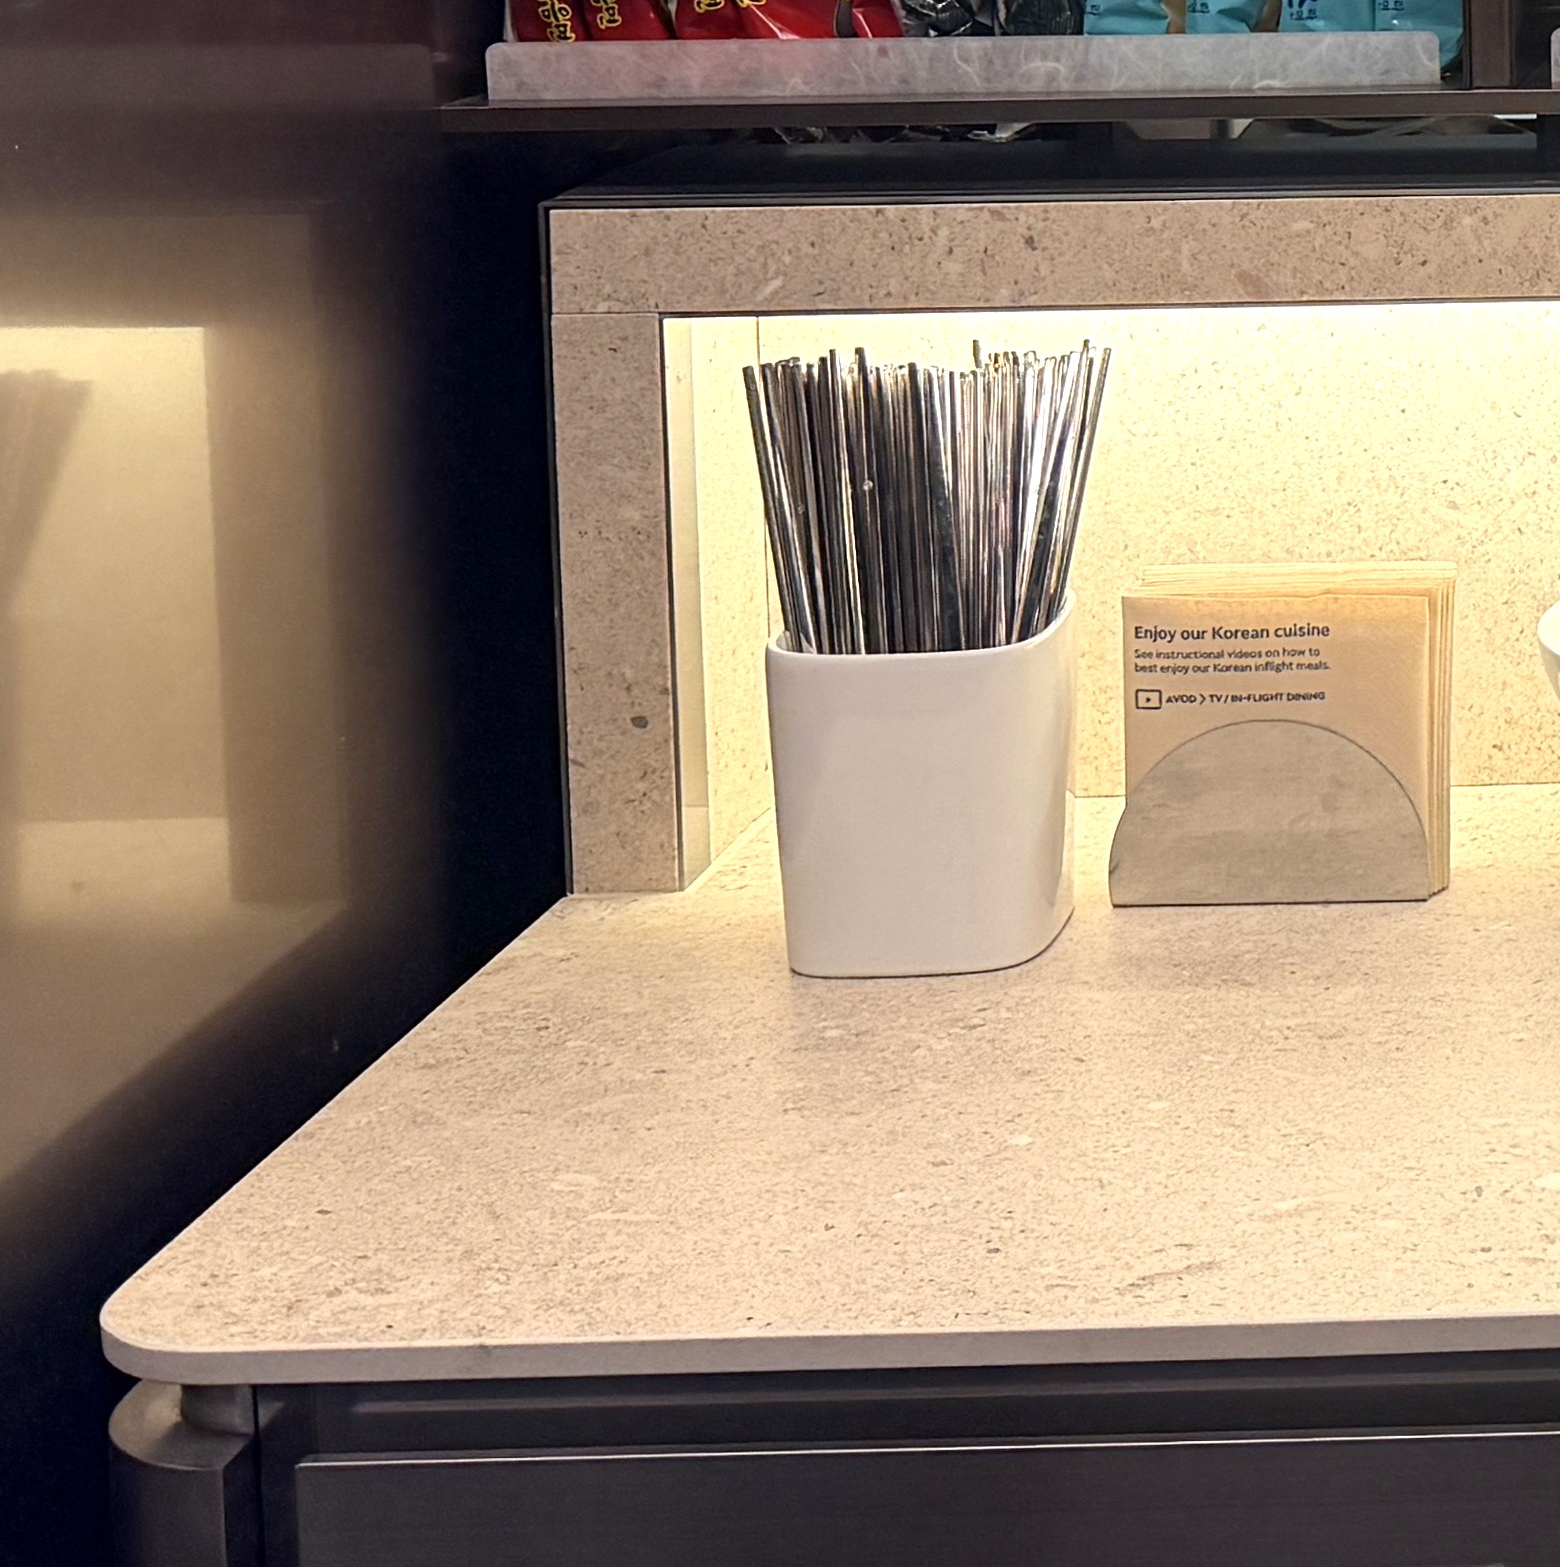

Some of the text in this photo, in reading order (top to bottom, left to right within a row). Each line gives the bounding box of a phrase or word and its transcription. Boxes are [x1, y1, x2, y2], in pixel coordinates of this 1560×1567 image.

[1134, 624, 1330, 642] Enjoy our Korean cuisine
[1134, 647, 1320, 660] See instructional videos on how to
[1134, 662, 1157, 674] best
[1160, 663, 1189, 676] enjoy
[1192, 663, 1210, 674] our
[1213, 662, 1252, 673] Korean
[1254, 661, 1293, 675] inflight
[1166, 694, 1196, 704] AVOD
[1209, 694, 1222, 704] TV
[1231, 692, 1284, 703] IN-FLIGHT
[1286, 691, 1325, 702] DINING
